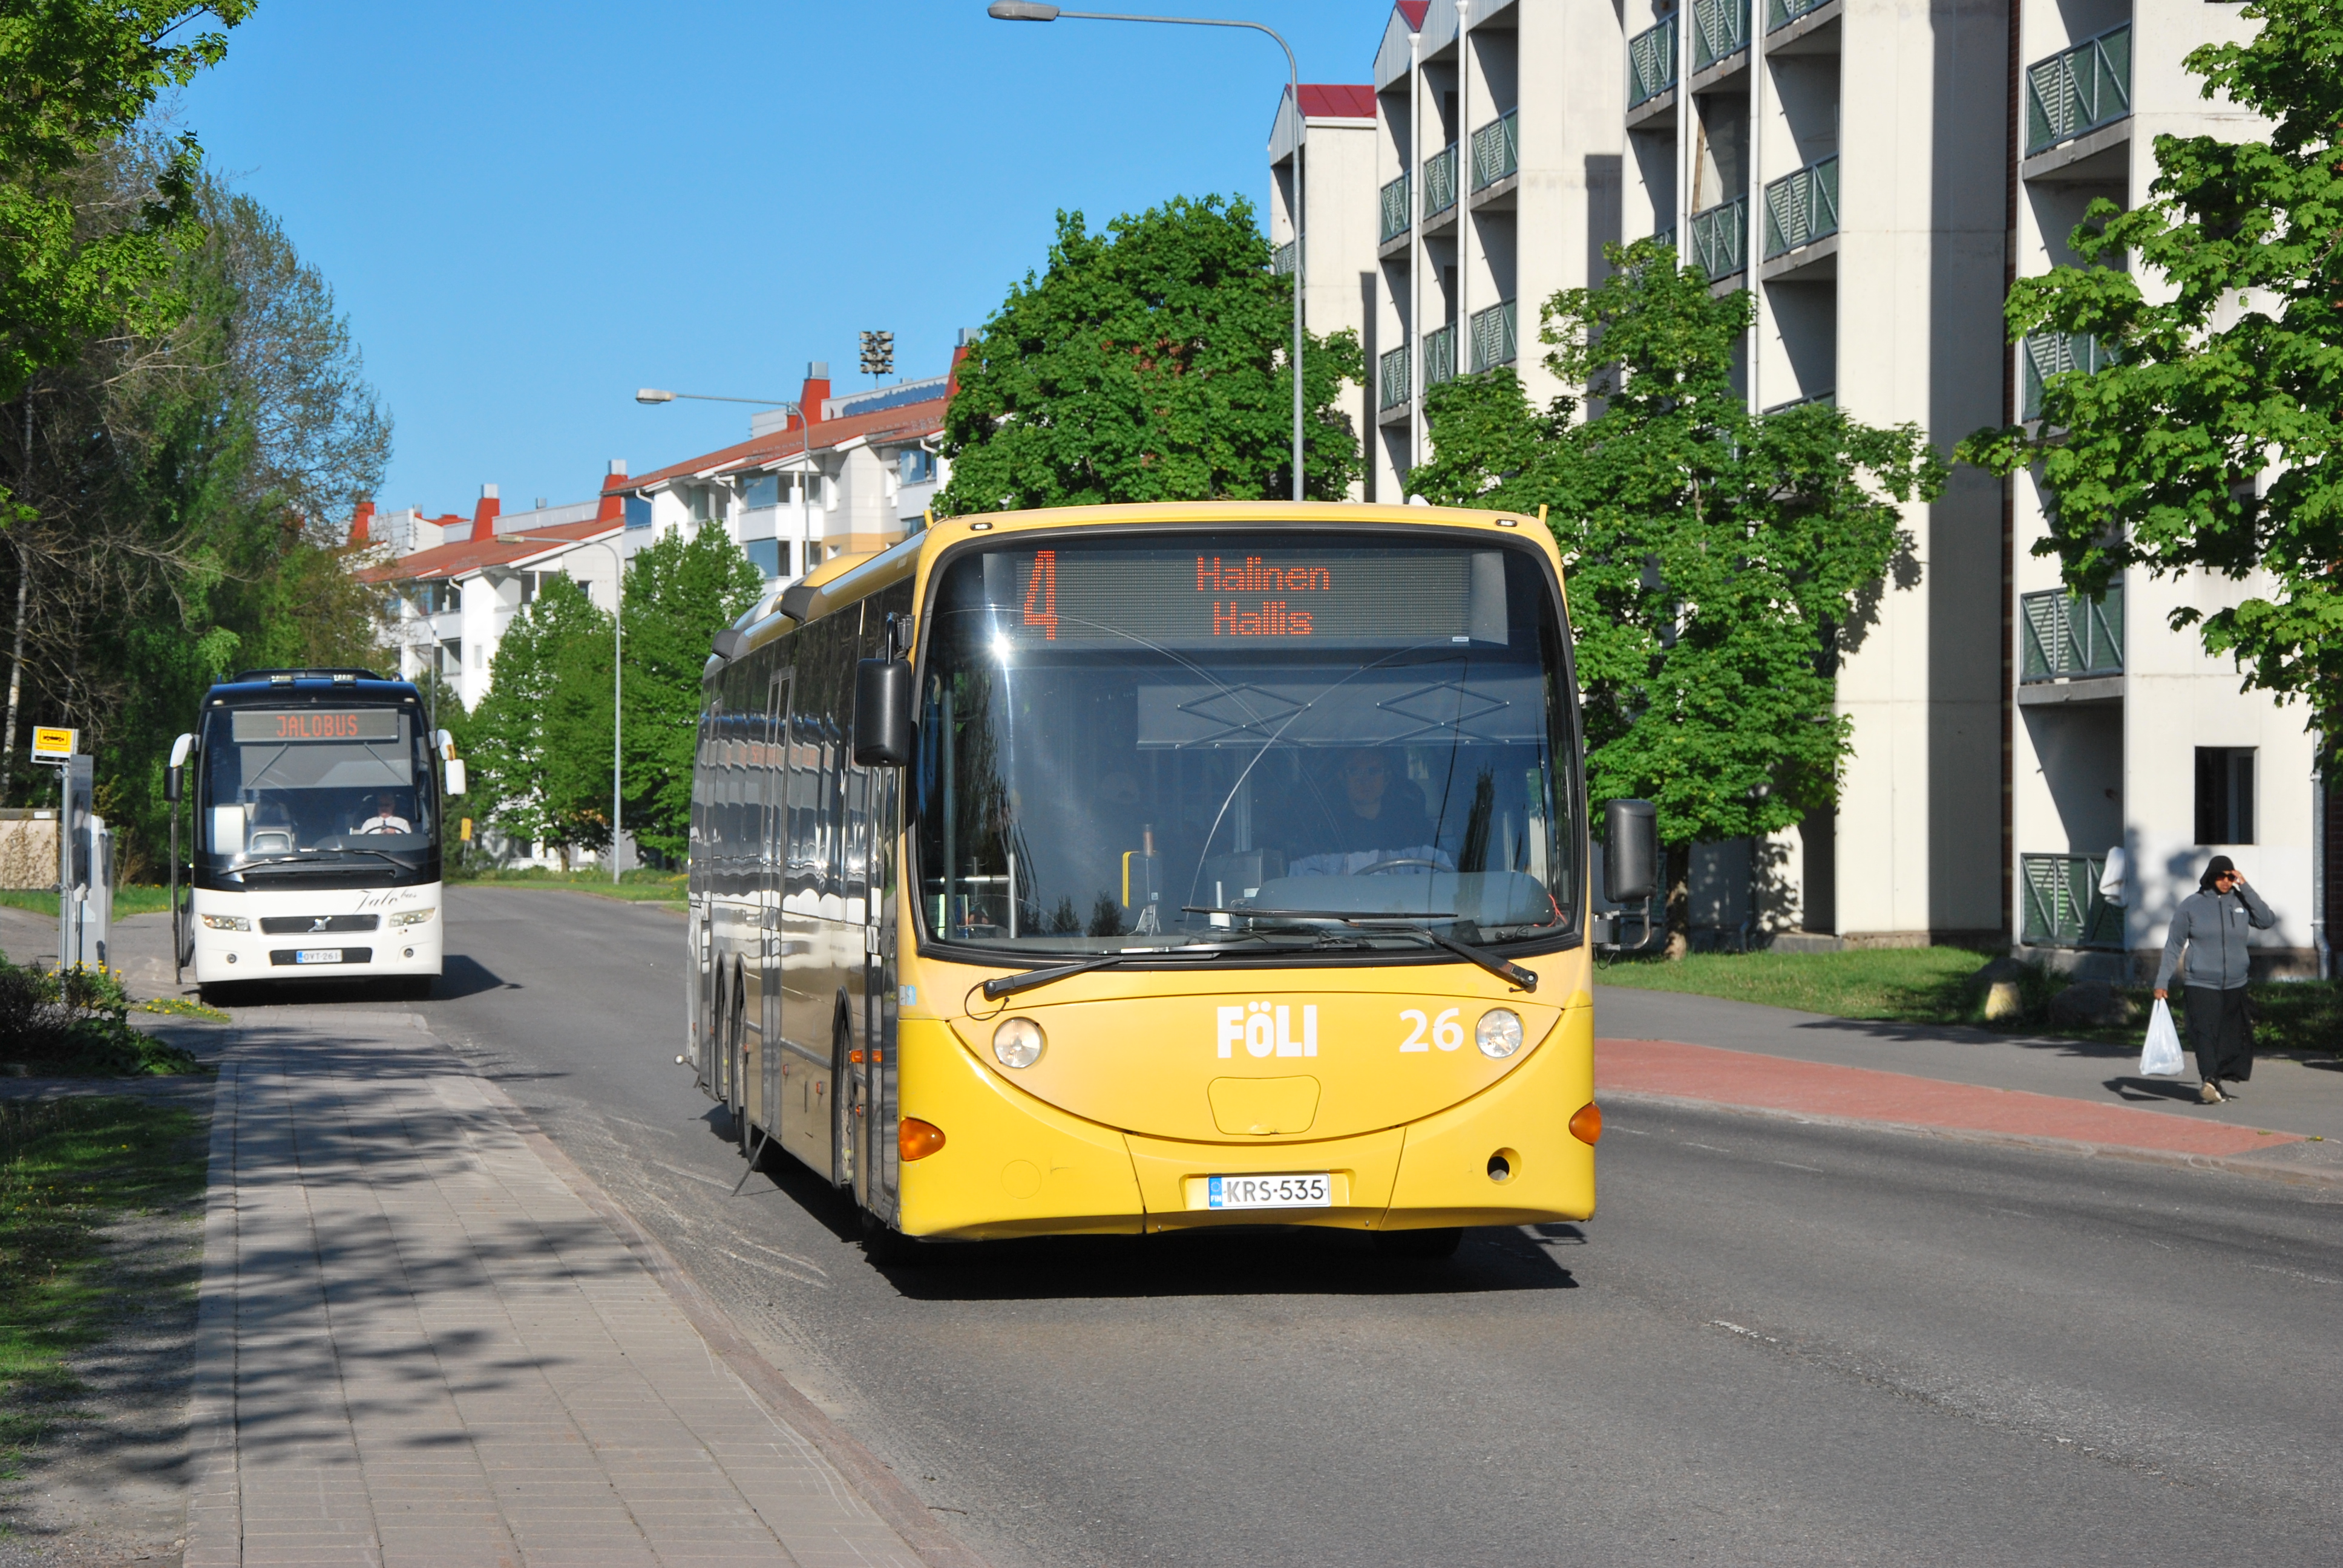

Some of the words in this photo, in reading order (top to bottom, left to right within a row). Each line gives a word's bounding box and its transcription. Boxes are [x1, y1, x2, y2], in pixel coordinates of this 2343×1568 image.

[1198, 557, 1329, 590] Halinen
[1024, 551, 1058, 639] 4
[1214, 601, 1312, 635] Hallis
[276, 714, 358, 737] JALOBUS
[1217, 1001, 1317, 1058] FÖLI
[1399, 1007, 1464, 1052] 26
[1226, 1180, 1323, 1202] KRS-535
